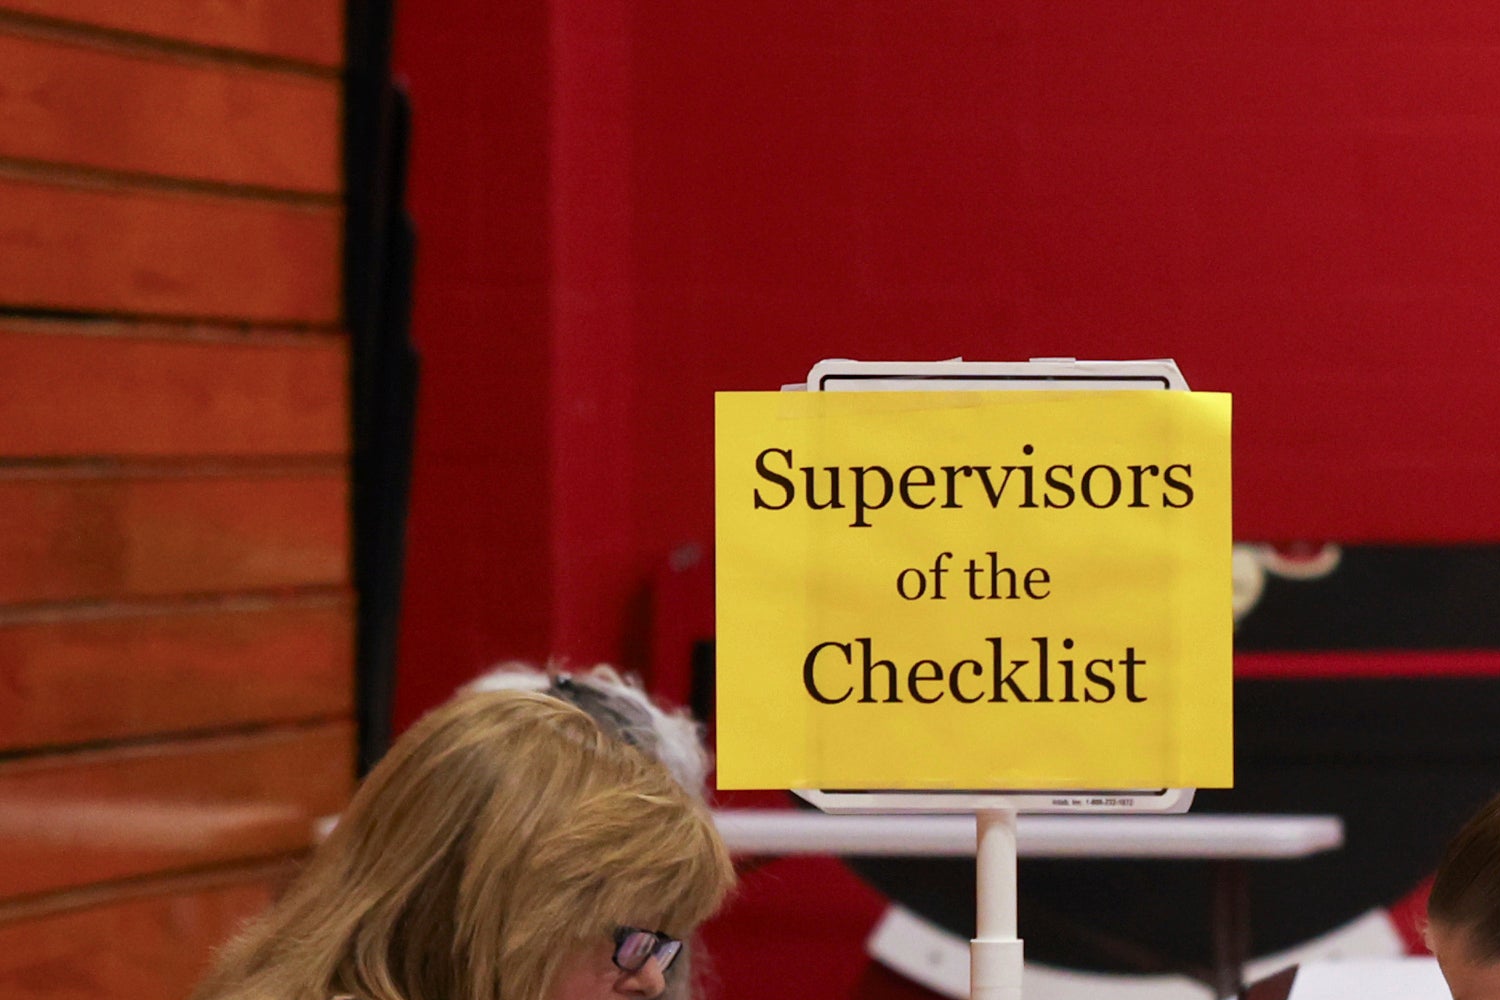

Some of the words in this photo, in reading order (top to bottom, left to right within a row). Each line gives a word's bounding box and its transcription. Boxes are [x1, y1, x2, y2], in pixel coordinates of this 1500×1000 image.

[753, 444, 1195, 528] Supervisors
[896, 551, 953, 601] of
[964, 551, 1051, 601] the
[802, 636, 1148, 705] Checklist
